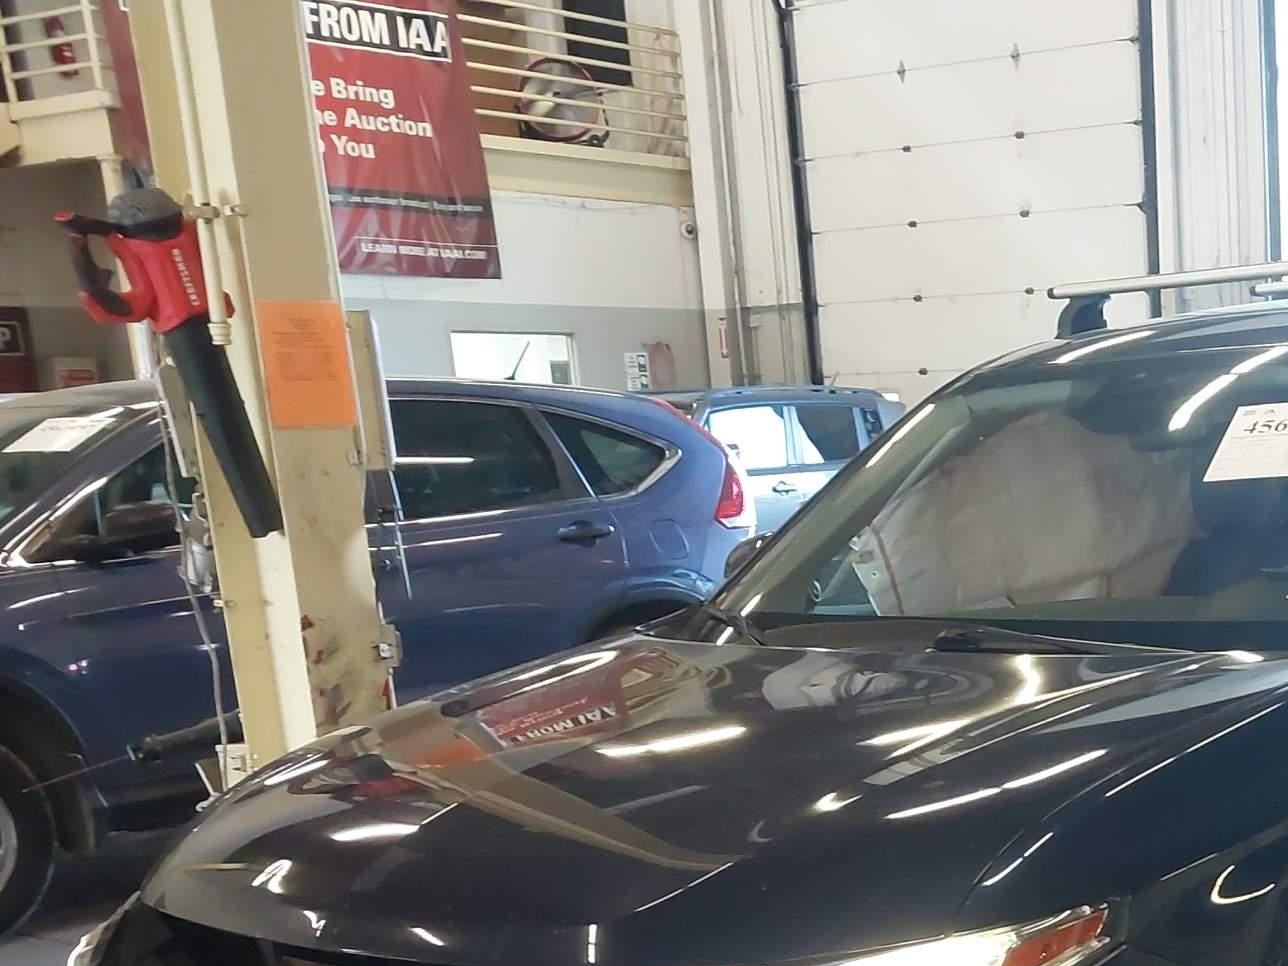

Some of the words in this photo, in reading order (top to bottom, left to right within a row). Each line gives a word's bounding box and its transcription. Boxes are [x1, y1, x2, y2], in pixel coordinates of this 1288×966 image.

[303, 1, 391, 46] FROM
[312, 79, 326, 97] e
[329, 76, 396, 109] Bring
[344, 107, 433, 138] Auction
[330, 133, 376, 159] You
